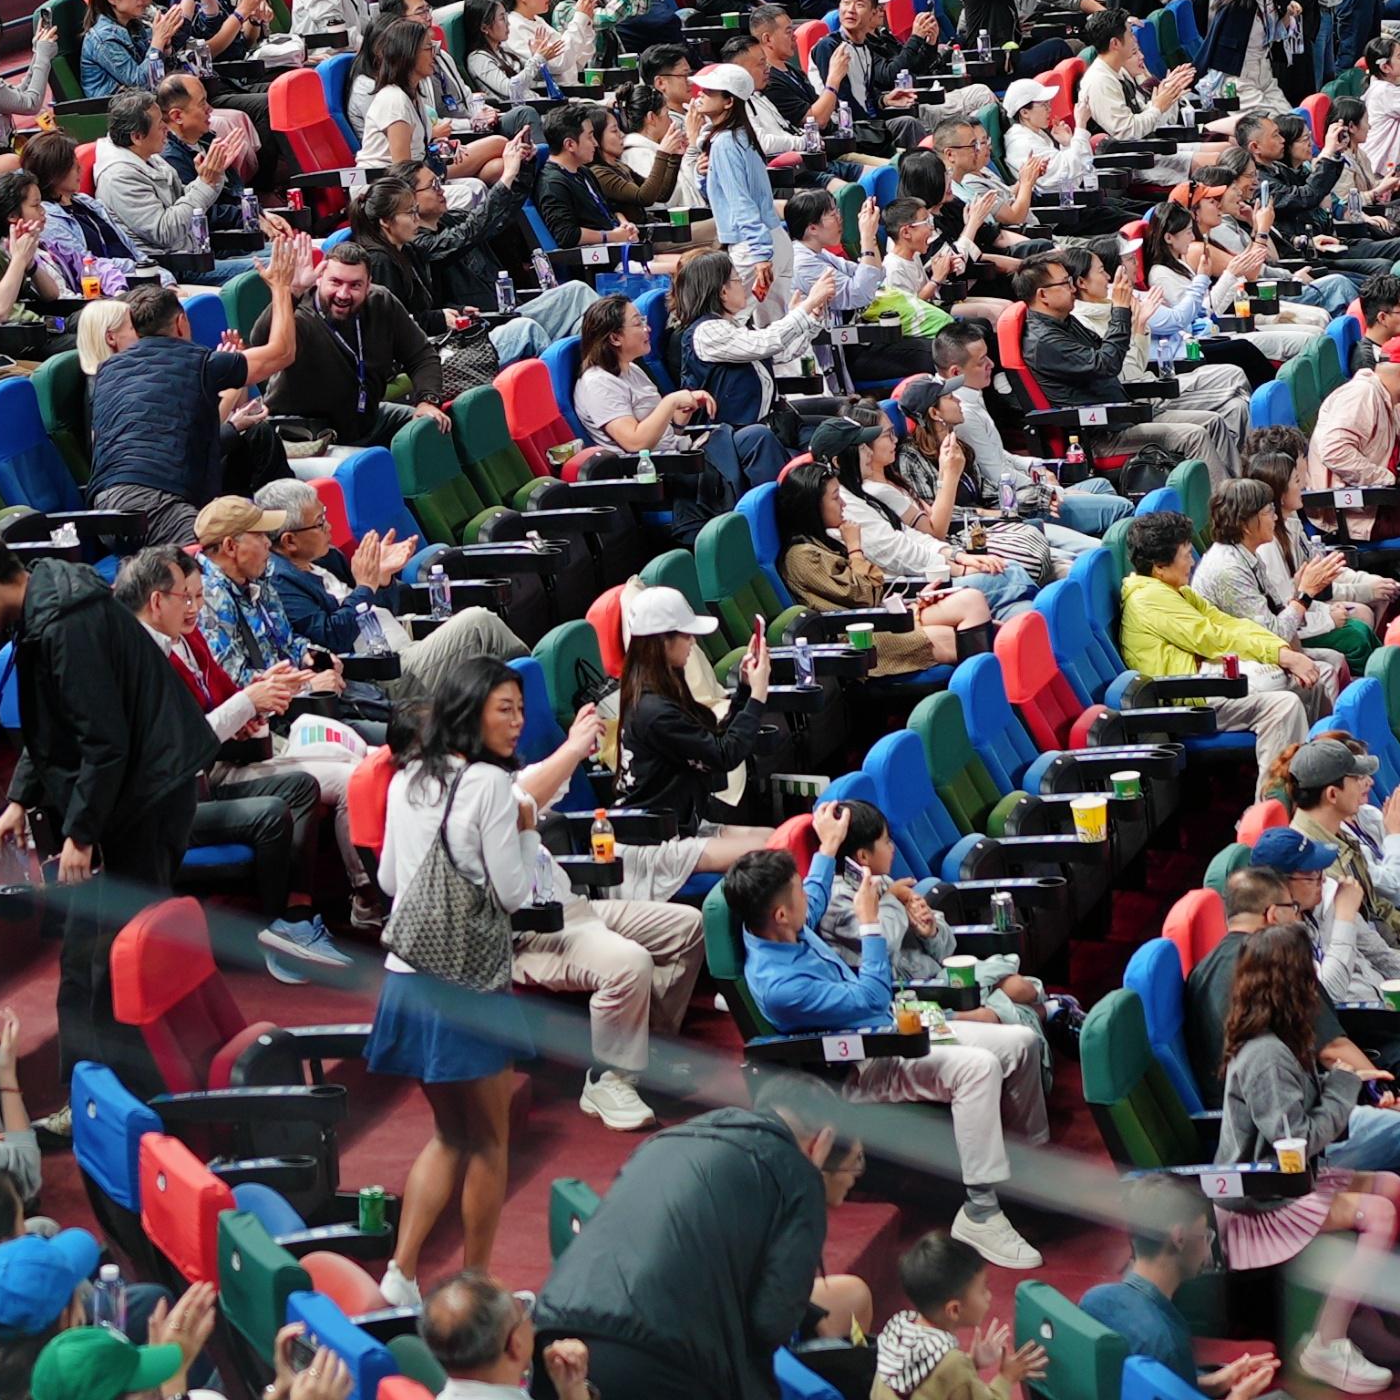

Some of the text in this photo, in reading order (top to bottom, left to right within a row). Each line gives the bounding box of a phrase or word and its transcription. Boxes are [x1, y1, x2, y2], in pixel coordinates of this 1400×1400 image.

[349, 173, 356, 184] 7
[591, 250, 600, 262] 6
[840, 330, 848, 343] 5
[1088, 412, 1096, 423] 4
[1344, 493, 1353, 505] 3
[838, 1041, 849, 1057] 3
[1216, 1177, 1228, 1194] 2
